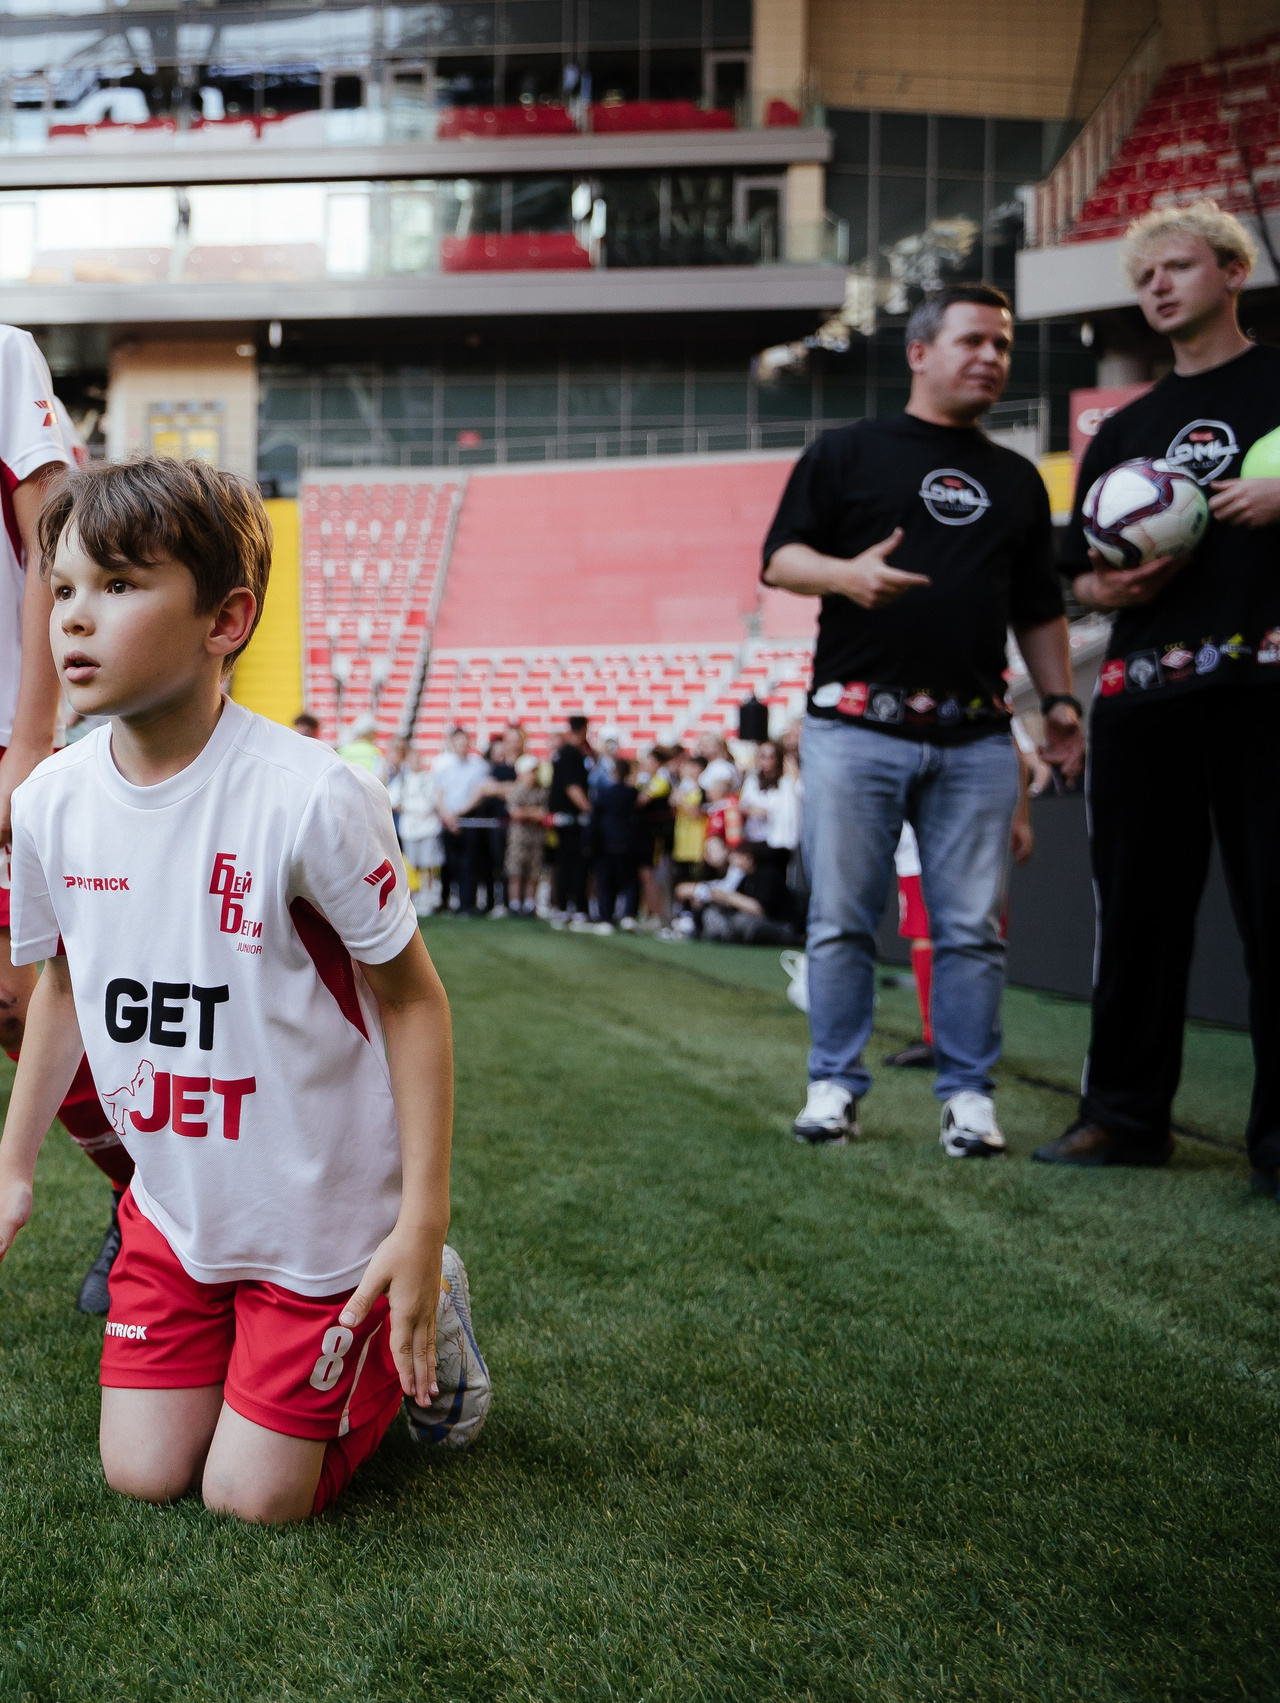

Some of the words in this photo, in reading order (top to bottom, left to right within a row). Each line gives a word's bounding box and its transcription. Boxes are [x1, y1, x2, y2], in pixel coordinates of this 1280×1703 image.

[75, 876, 131, 891] PATRICK
[236, 942, 263, 955] JUNIOR
[104, 976, 230, 1051] GET
[128, 1071, 257, 1141] JET
[309, 1325, 354, 1392] 8
